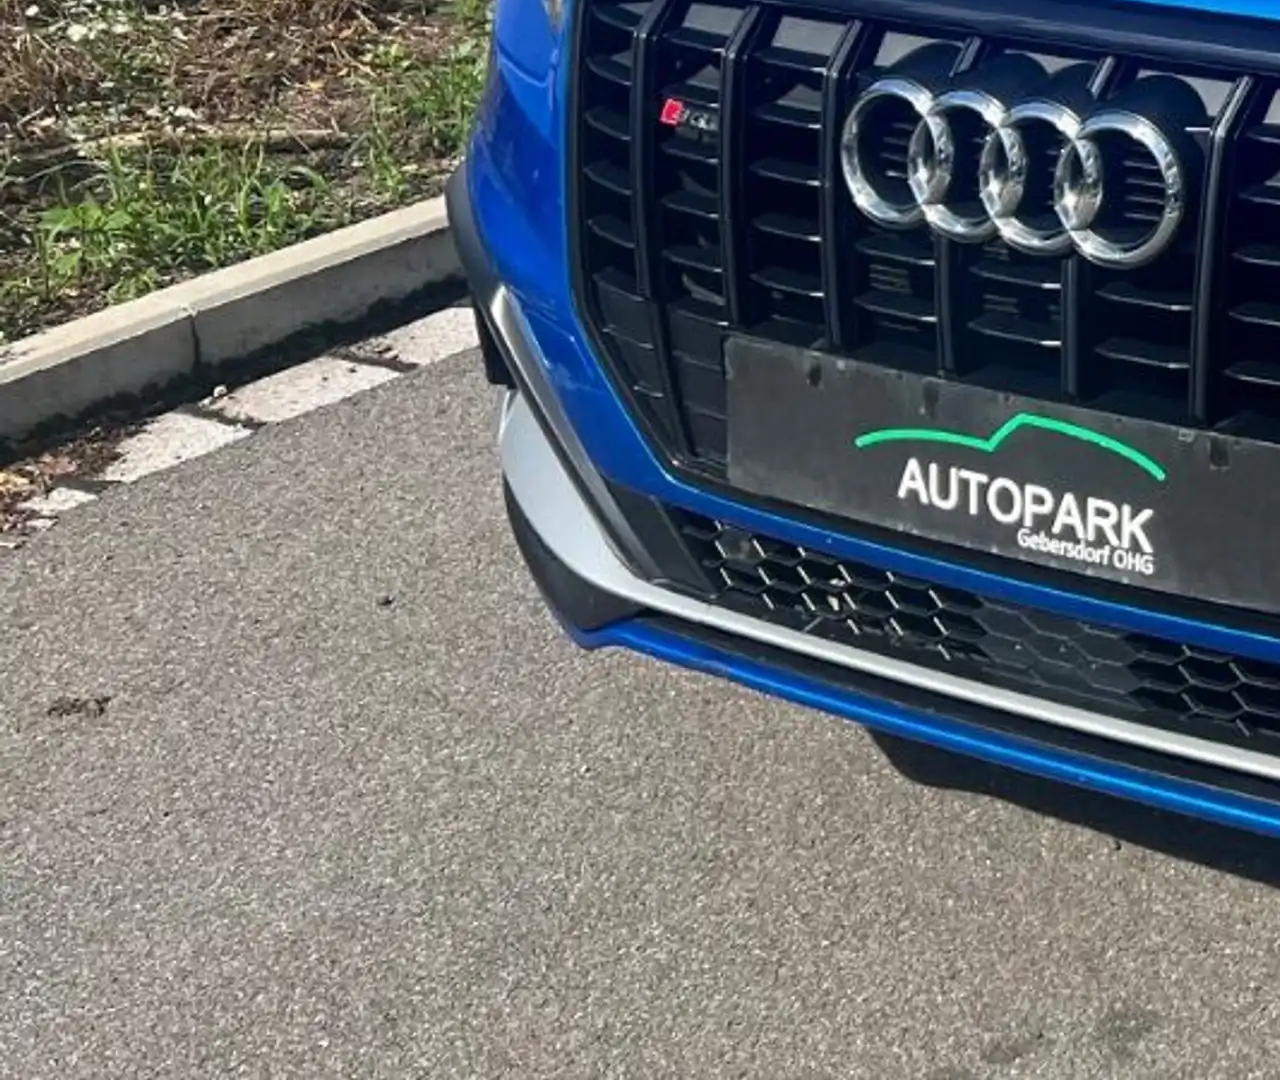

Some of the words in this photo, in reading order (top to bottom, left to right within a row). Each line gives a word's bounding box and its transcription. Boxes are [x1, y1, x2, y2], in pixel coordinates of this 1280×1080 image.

[897, 457, 1155, 554] AUTOPARK
[1017, 527, 1111, 565] Gebersdorf
[1112, 549, 1155, 575] OHG
